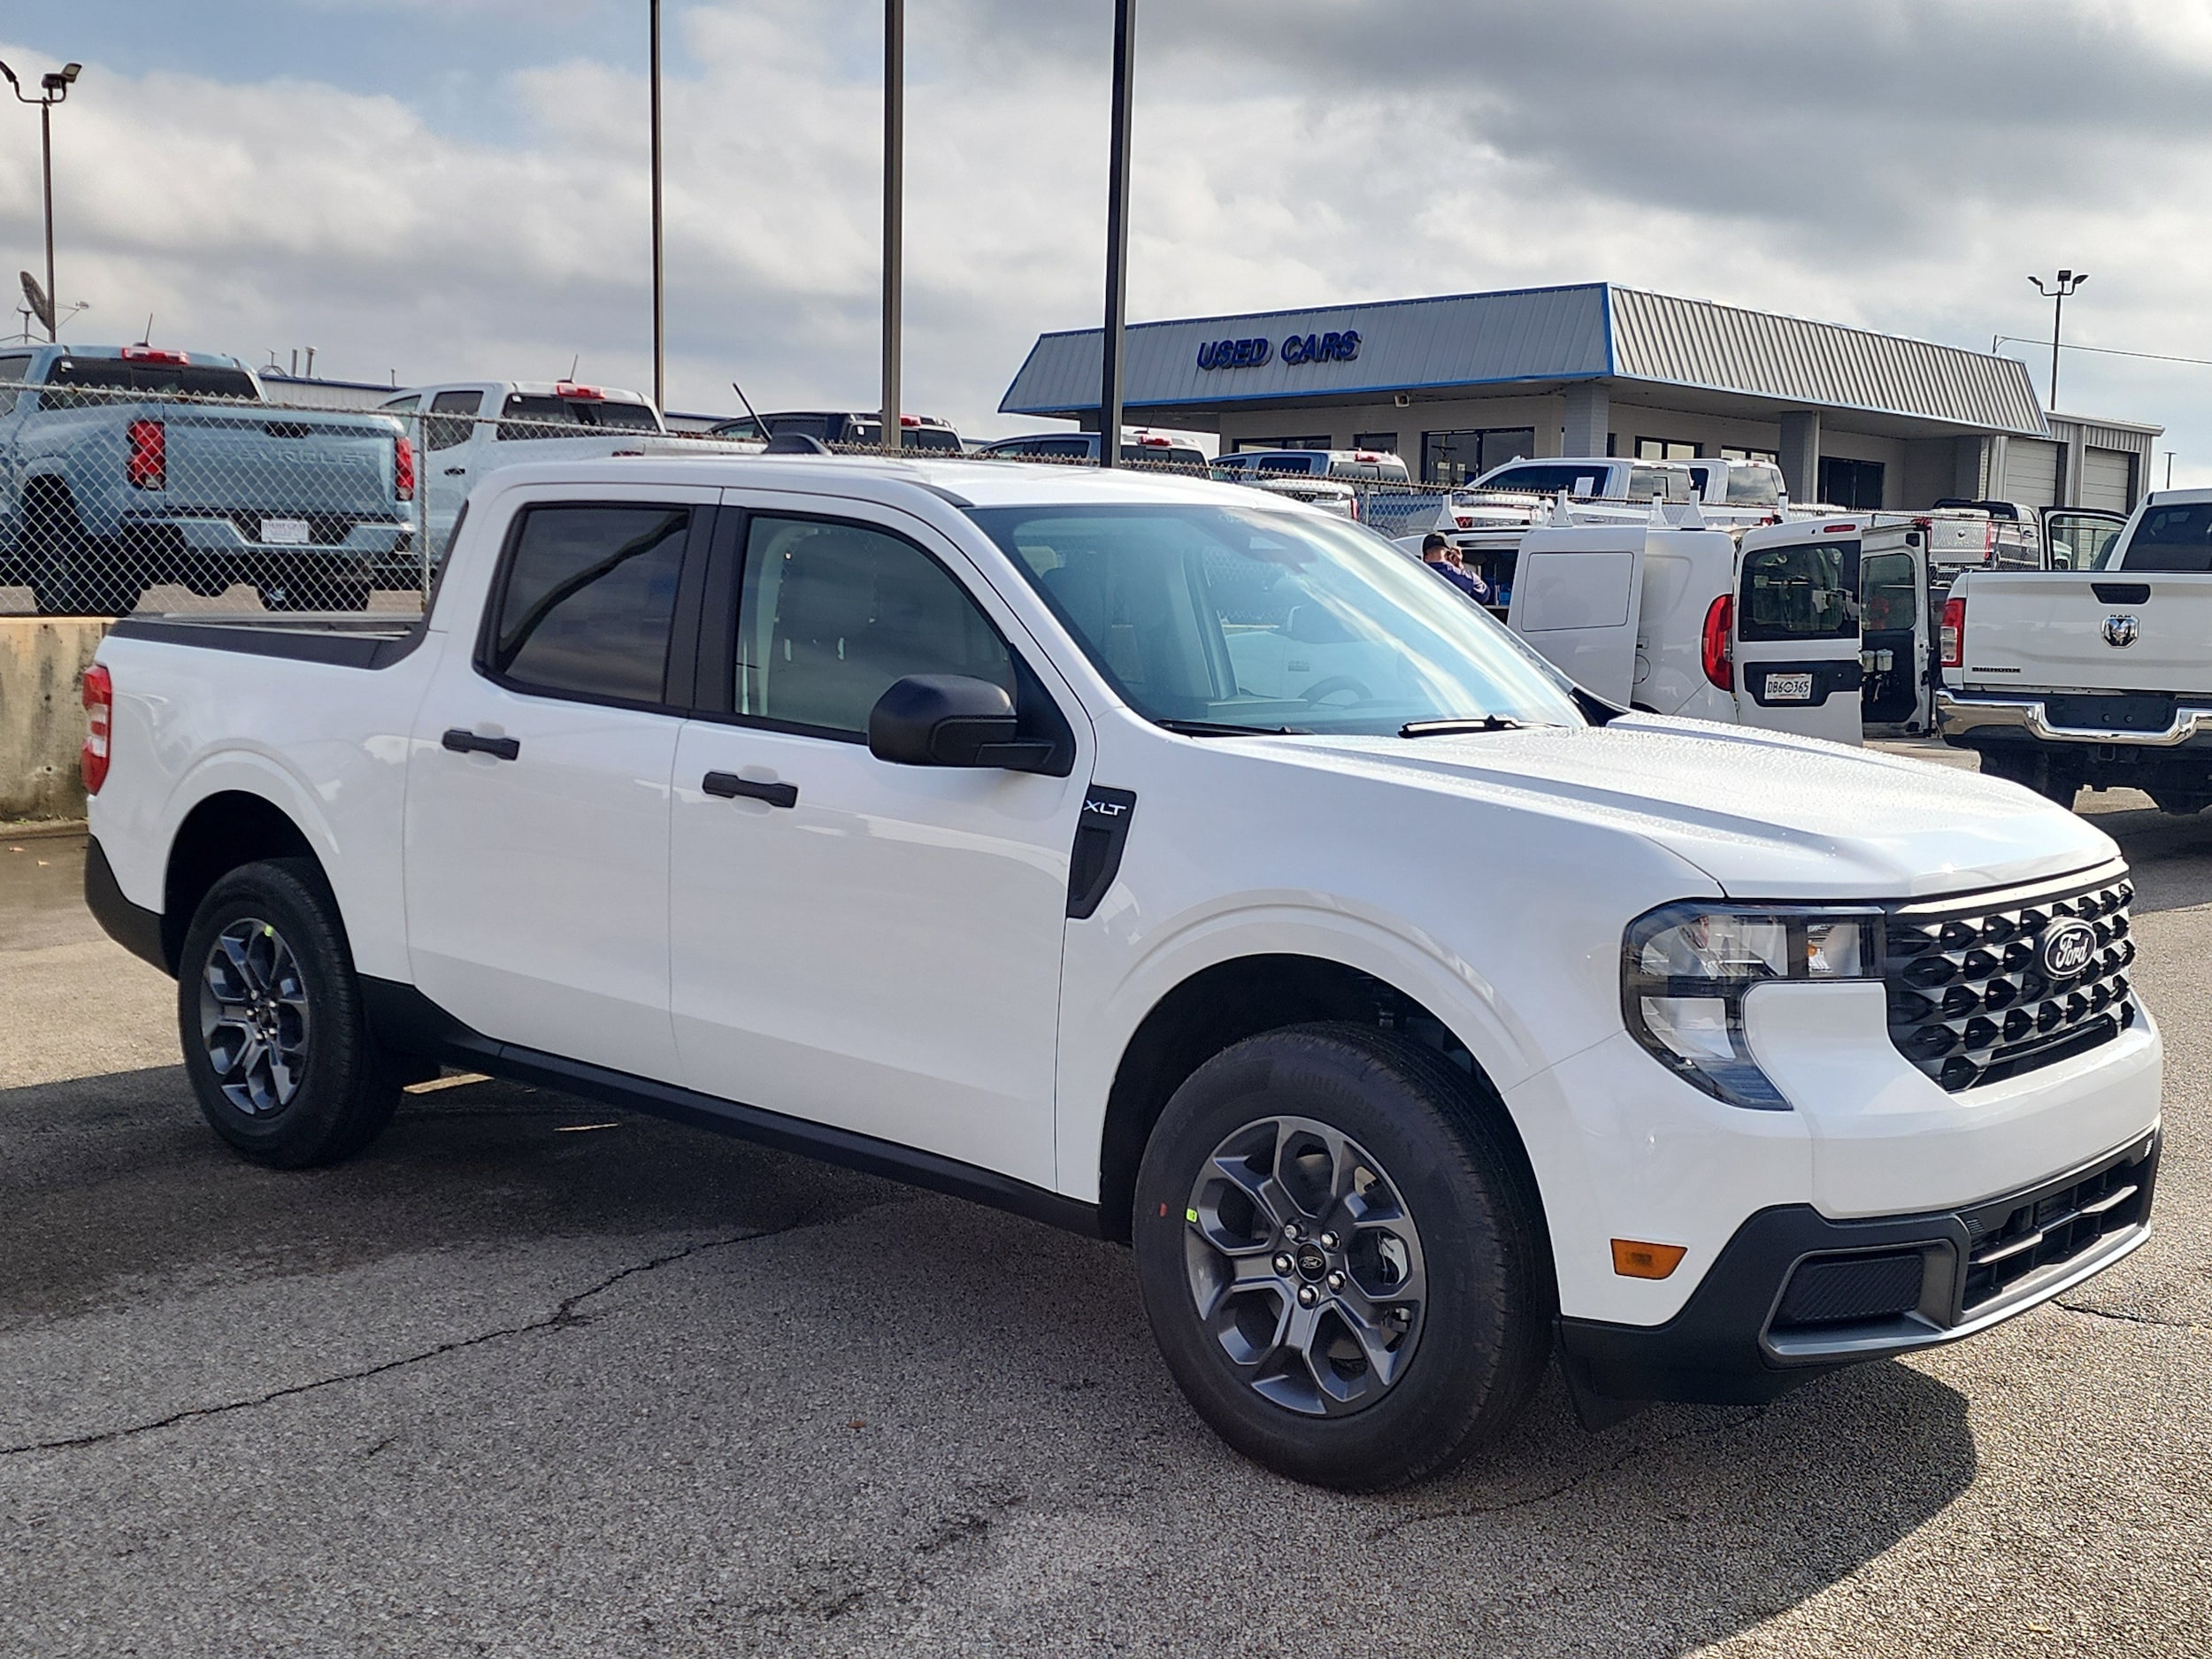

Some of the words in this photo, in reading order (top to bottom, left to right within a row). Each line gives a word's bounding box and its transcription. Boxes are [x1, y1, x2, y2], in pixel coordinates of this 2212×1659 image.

[1197, 338, 1272, 370] USED
[1281, 330, 1361, 365] CARS
[1083, 799, 1127, 816] XLT
[2055, 932, 2089, 969] Ford
